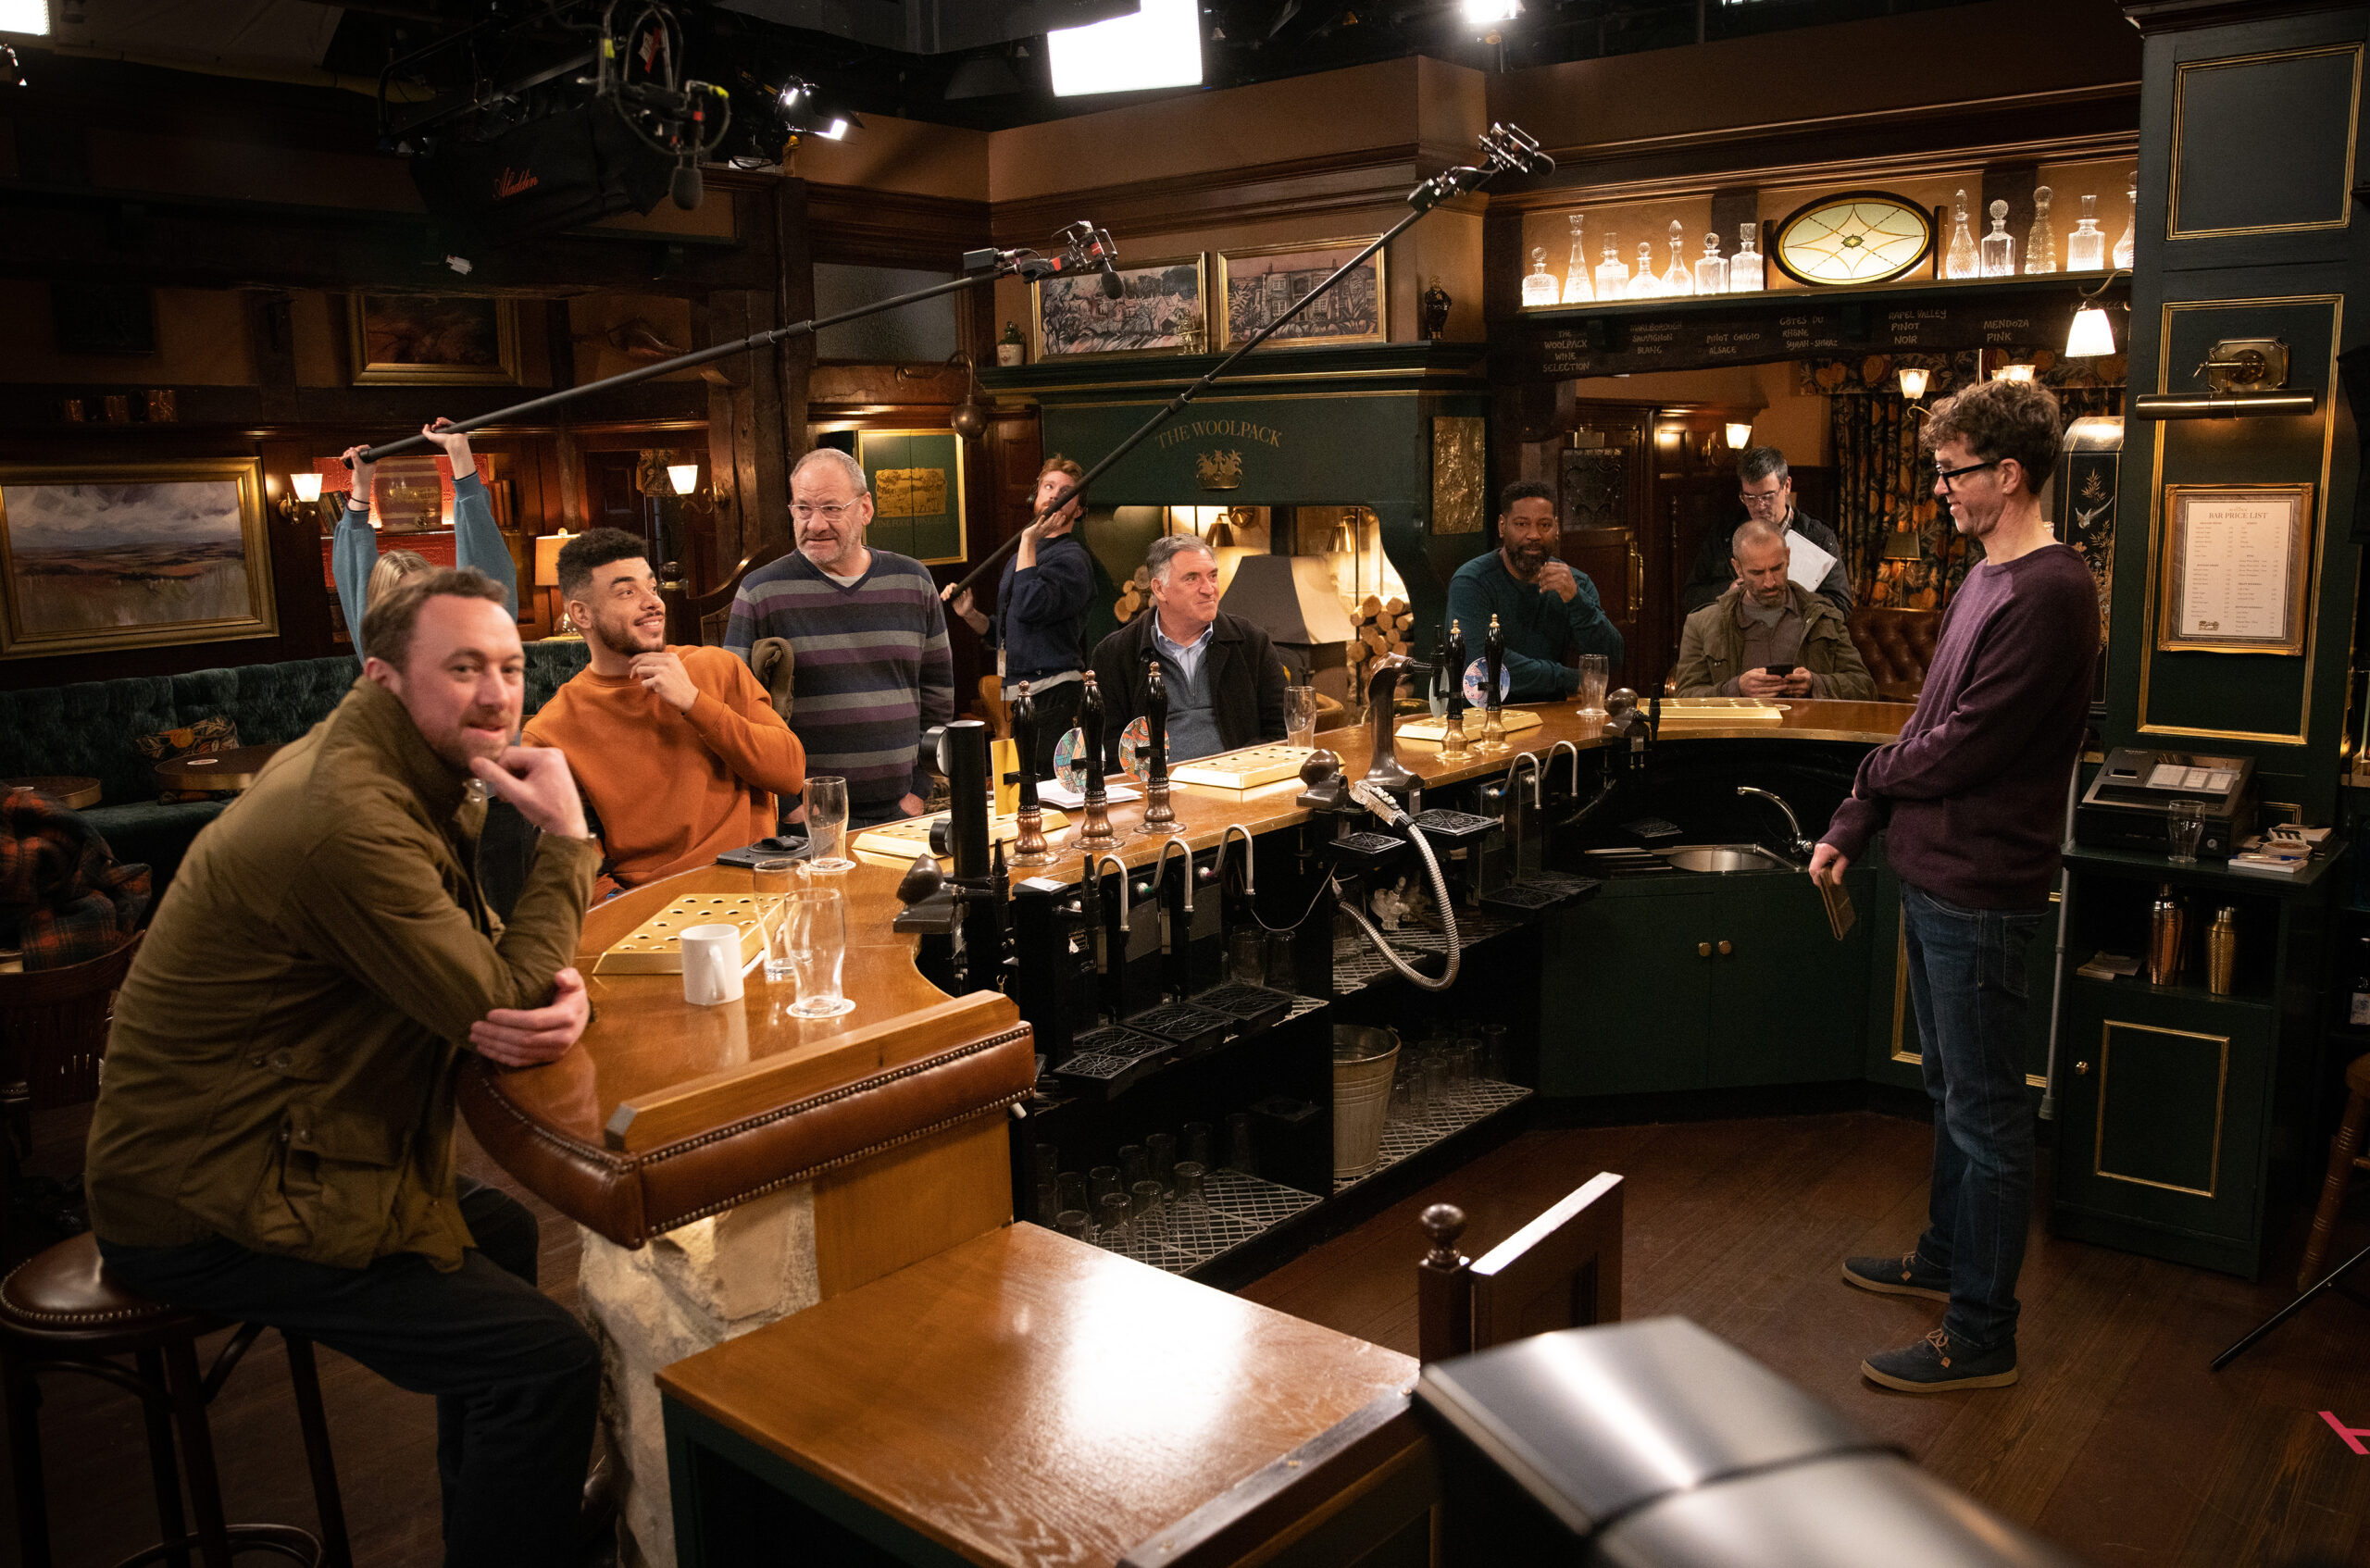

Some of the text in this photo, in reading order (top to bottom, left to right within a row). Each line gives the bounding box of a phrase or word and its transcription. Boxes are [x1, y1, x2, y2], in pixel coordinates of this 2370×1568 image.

[492, 166, 539, 200] Aladdin
[1812, 315, 1825, 324] DU
[1889, 309, 1947, 320] RAPEL VALLEY
[1890, 321, 1920, 331] PINOT
[1983, 319, 2029, 330] MENDOZA
[1558, 330, 1572, 338] THE
[1631, 333, 1674, 343] SAUVIGNON
[1706, 332, 1761, 343] PINOT GRIGIO
[1987, 332, 2013, 342] PINK
[1543, 339, 1588, 349] WOOLPACK
[1894, 335, 1918, 344] NOIR
[1637, 345, 1663, 355] BLANC
[1709, 345, 1738, 355] ALSACE
[1554, 352, 1578, 361] WINE
[1542, 361, 1590, 373] SELECTION
[1157, 419, 1282, 449] THE WOOLPACK
